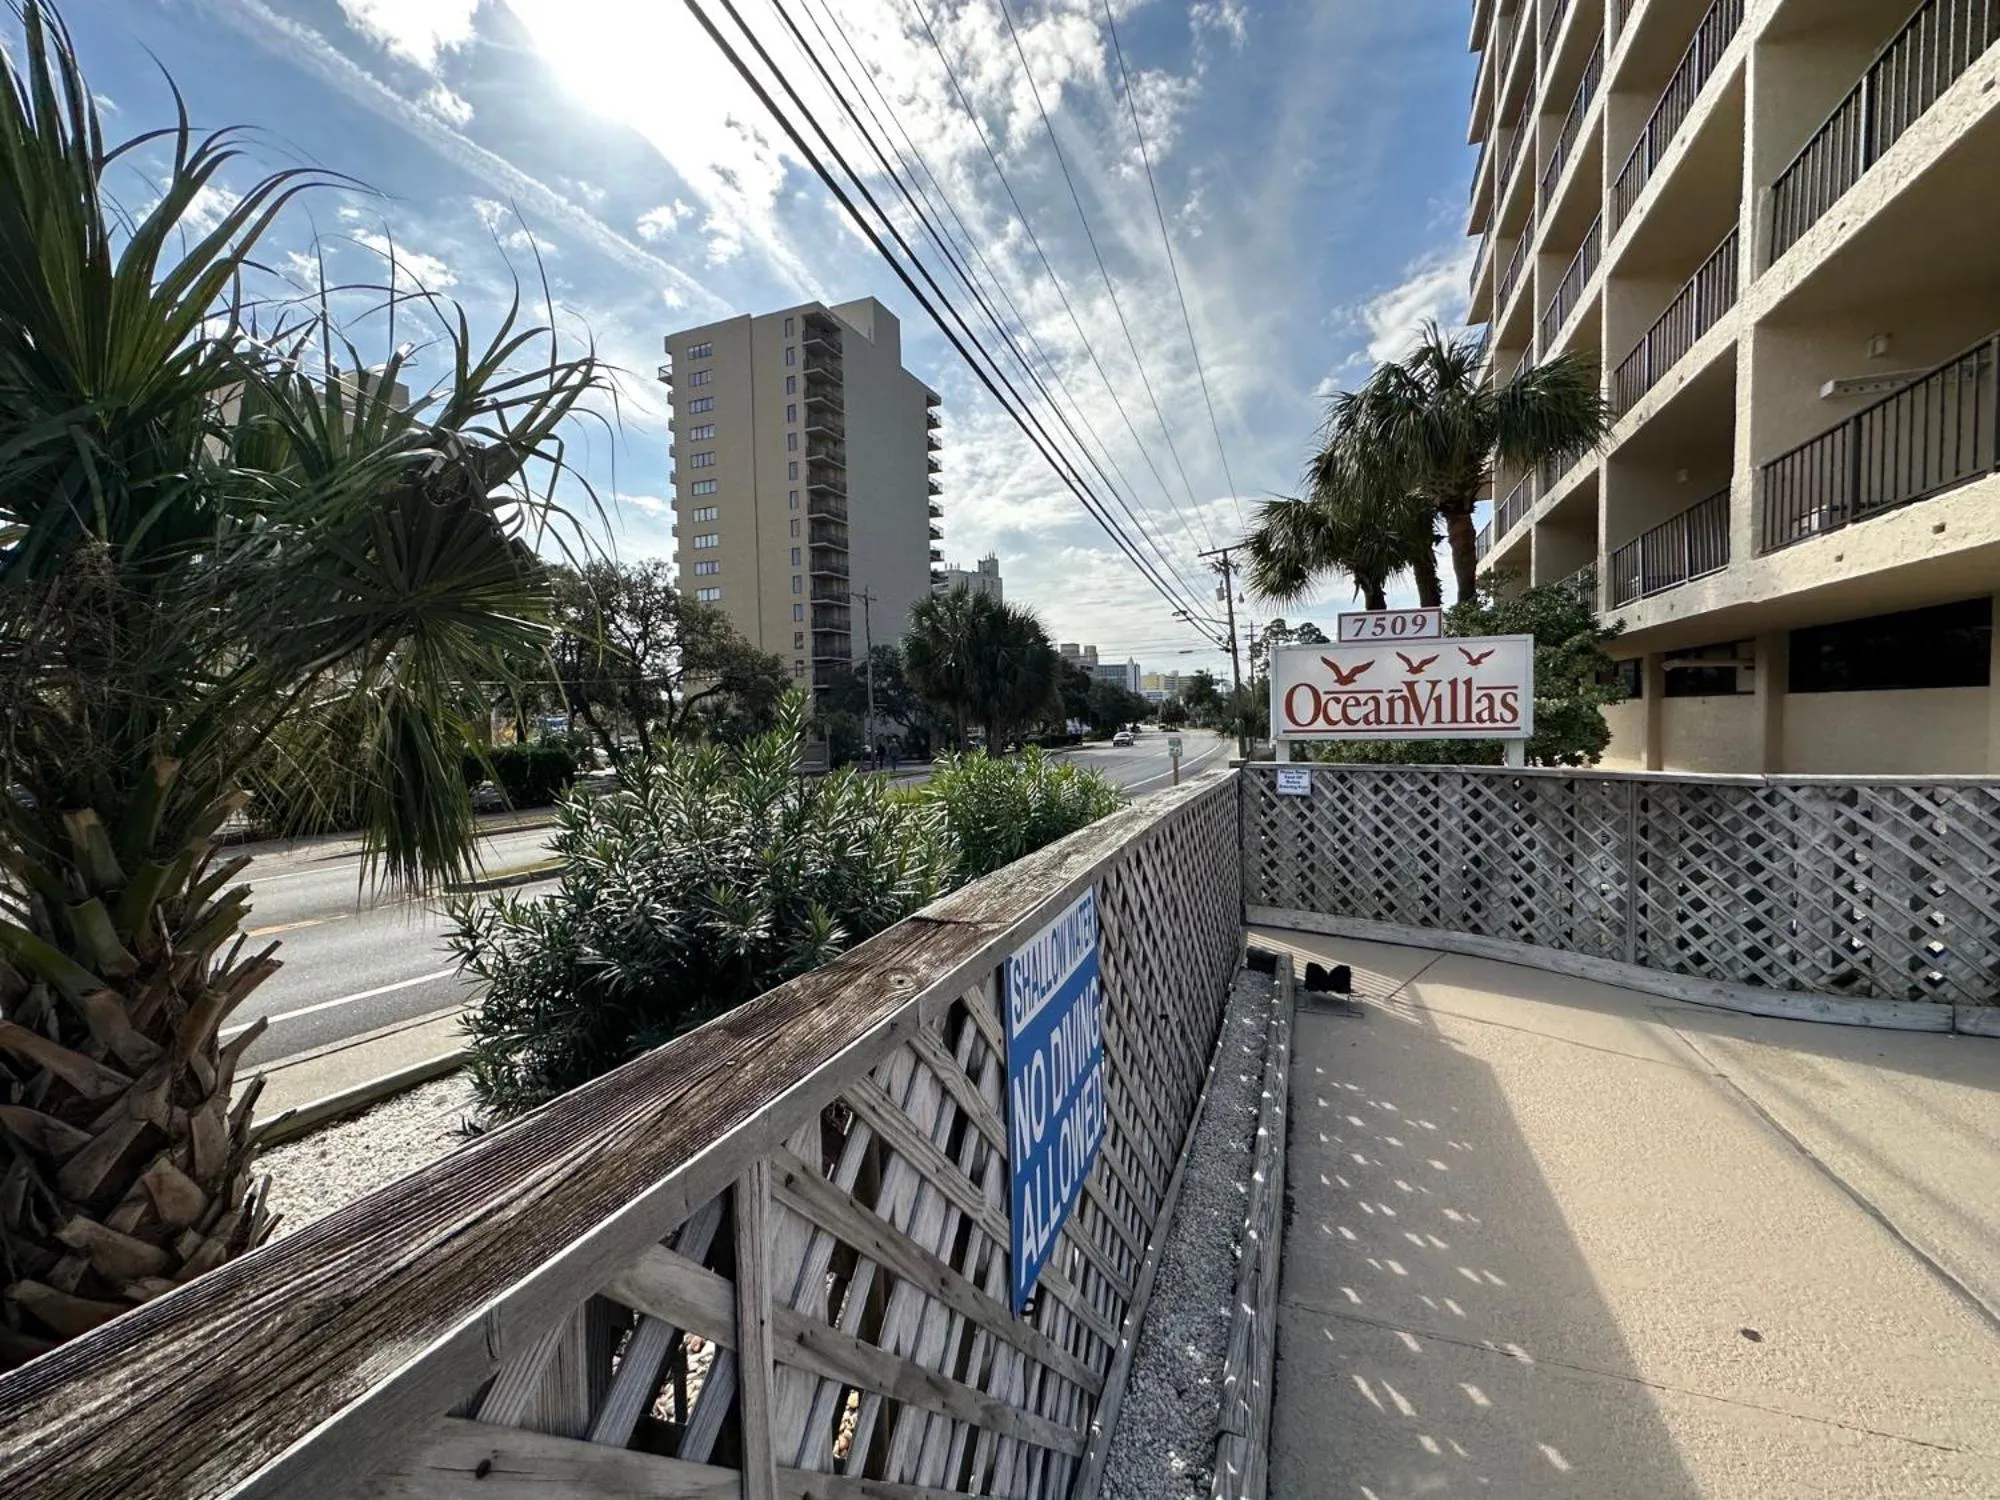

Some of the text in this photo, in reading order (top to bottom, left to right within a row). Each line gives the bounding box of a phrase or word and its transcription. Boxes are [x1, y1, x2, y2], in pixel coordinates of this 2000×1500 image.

[1352, 614, 1428, 638] 7509
[1013, 917, 1067, 1024] SHALLOW
[1013, 975, 1100, 1175] NO DIVING
[1020, 1062, 1101, 1289] ALLOWED
